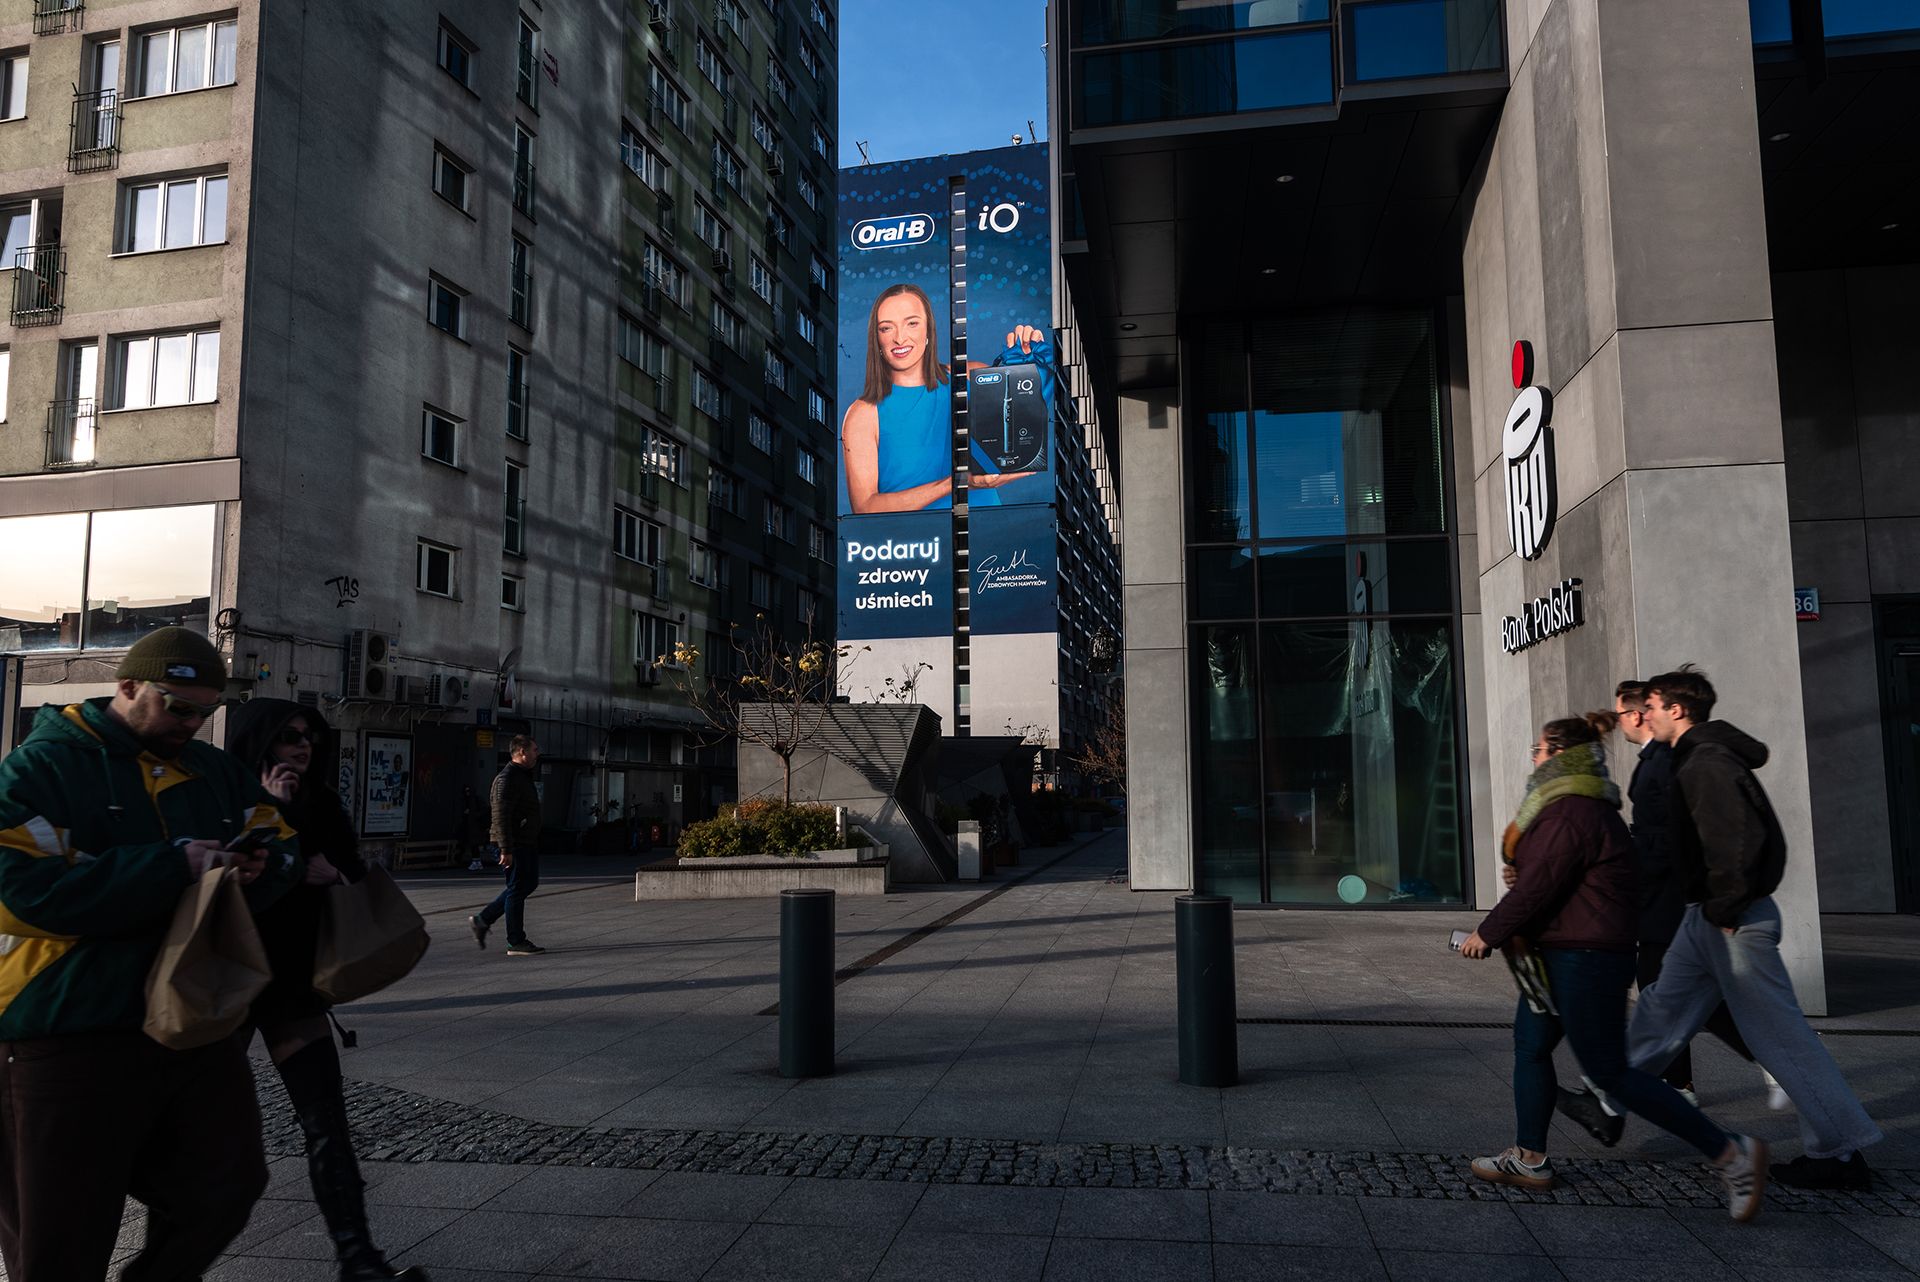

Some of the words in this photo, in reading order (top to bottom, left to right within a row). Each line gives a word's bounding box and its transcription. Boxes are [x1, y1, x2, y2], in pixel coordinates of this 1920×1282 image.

[858, 220, 926, 244] Oral-B
[847, 537, 939, 562] Podaruj
[858, 568, 929, 585] zdrowy
[996, 574, 1038, 582] AMBASADORKA
[1018, 579, 1047, 588] NAWYKÓW
[325, 576, 359, 597] TAS
[855, 591, 933, 609] uśmiech
[1501, 609, 1531, 653] Bank
[1533, 578, 1577, 643] Polski
